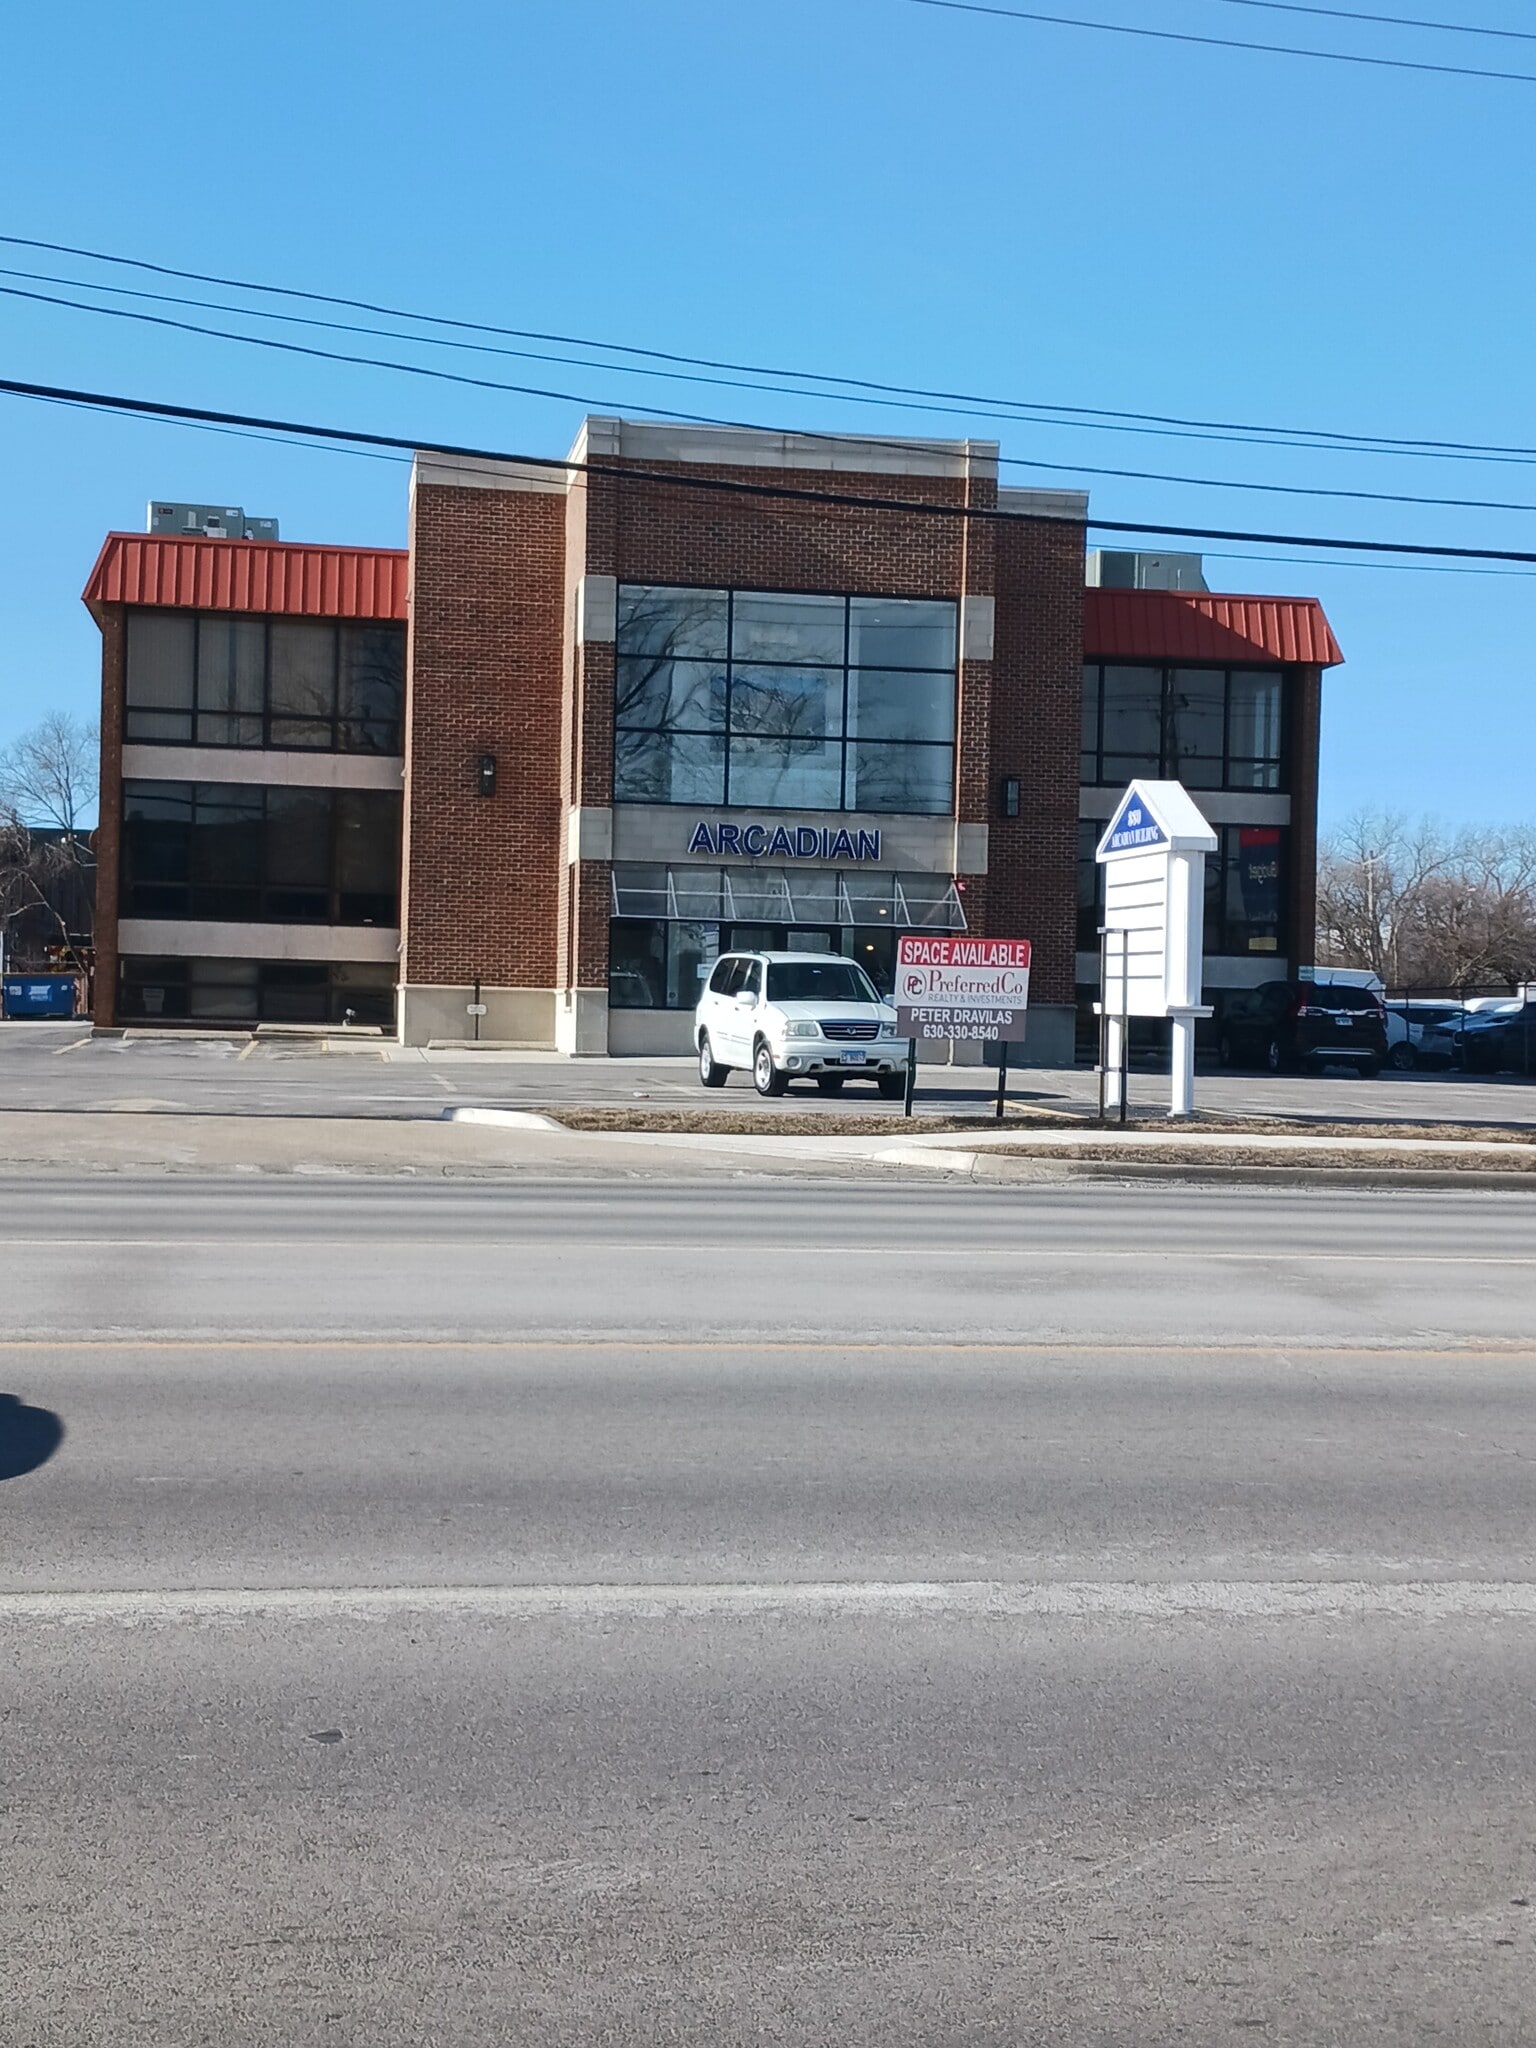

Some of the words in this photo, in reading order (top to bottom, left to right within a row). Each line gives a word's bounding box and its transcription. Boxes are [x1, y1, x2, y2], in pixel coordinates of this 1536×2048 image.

[687, 821, 881, 861] ARCADIAN
[904, 941, 950, 964] SPACE
[951, 943, 1025, 966] AVAILABLE
[928, 993, 959, 1003] REALTY
[967, 995, 1022, 1005] INVESTMENTS
[911, 1008, 951, 1022] PETER
[953, 1010, 1013, 1025] DRAVILAS
[923, 1024, 999, 1040] 630-330-8540
